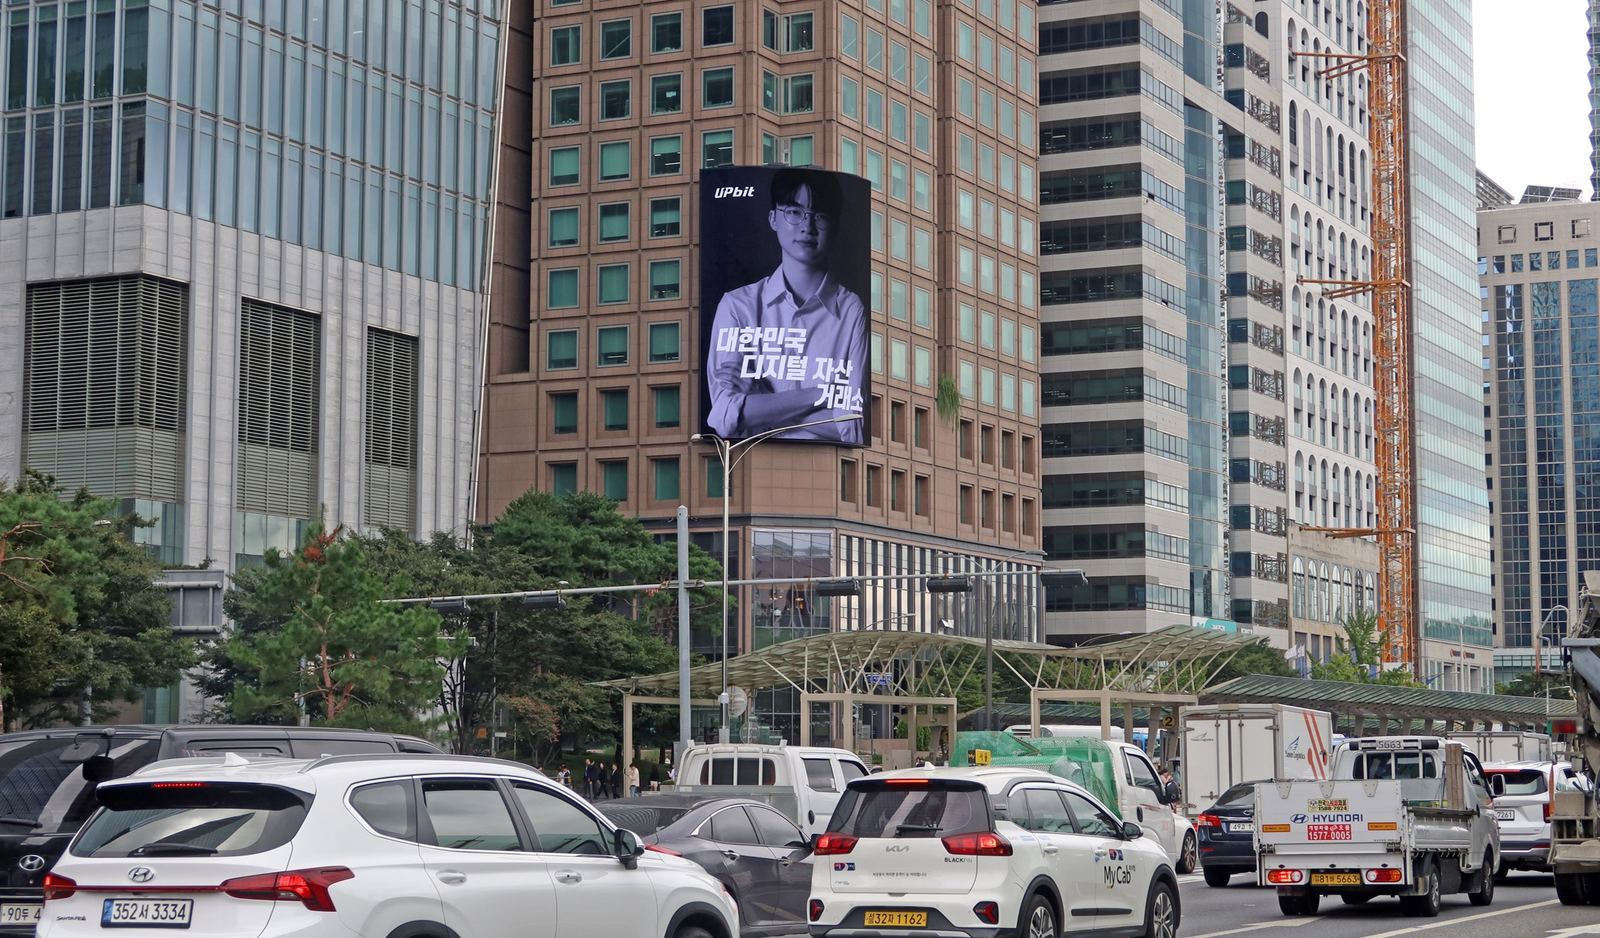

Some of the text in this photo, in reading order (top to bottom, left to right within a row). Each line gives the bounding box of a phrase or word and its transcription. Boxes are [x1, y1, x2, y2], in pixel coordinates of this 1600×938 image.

[716, 327, 807, 353] 대한민국
[740, 354, 854, 385] 디지털 자산
[813, 384, 864, 412] 거래소
[1165, 716, 1173, 727] 2
[1313, 814, 1364, 823] HYUNDAI
[1337, 875, 1358, 883] 5663
[113, 903, 187, 921] 352서 3334
[897, 913, 923, 925] 1162
